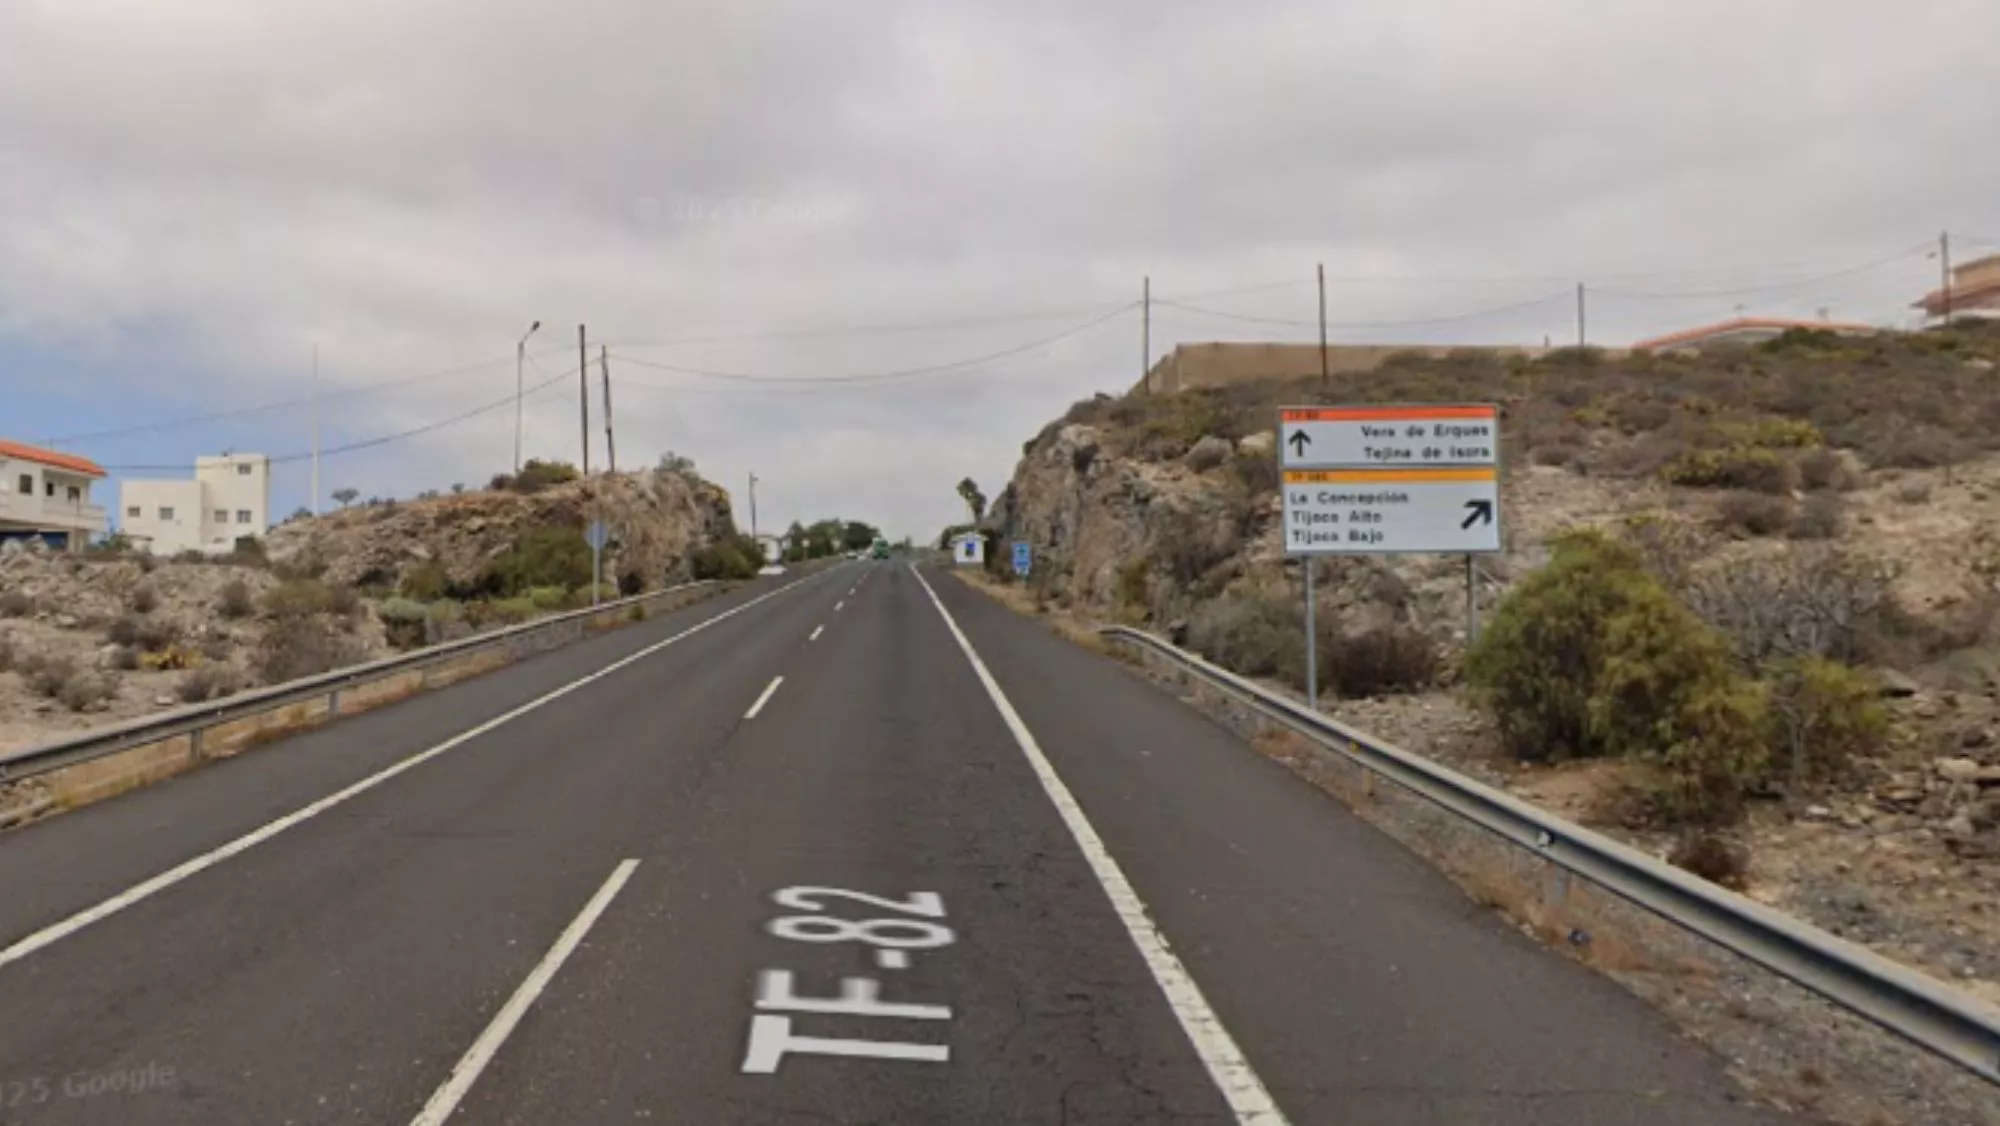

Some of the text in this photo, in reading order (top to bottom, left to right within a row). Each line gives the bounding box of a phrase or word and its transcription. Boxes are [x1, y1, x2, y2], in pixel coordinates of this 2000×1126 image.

[1361, 423, 1489, 440] Vera de Erques
[1364, 446, 1411, 462] Tejina
[1422, 446, 1442, 459] de
[1289, 490, 1408, 505] La Concepción
[1349, 510, 1382, 523] Alto
[1349, 528, 1383, 544] Bajo
[741, 885, 956, 1073] TF-82
